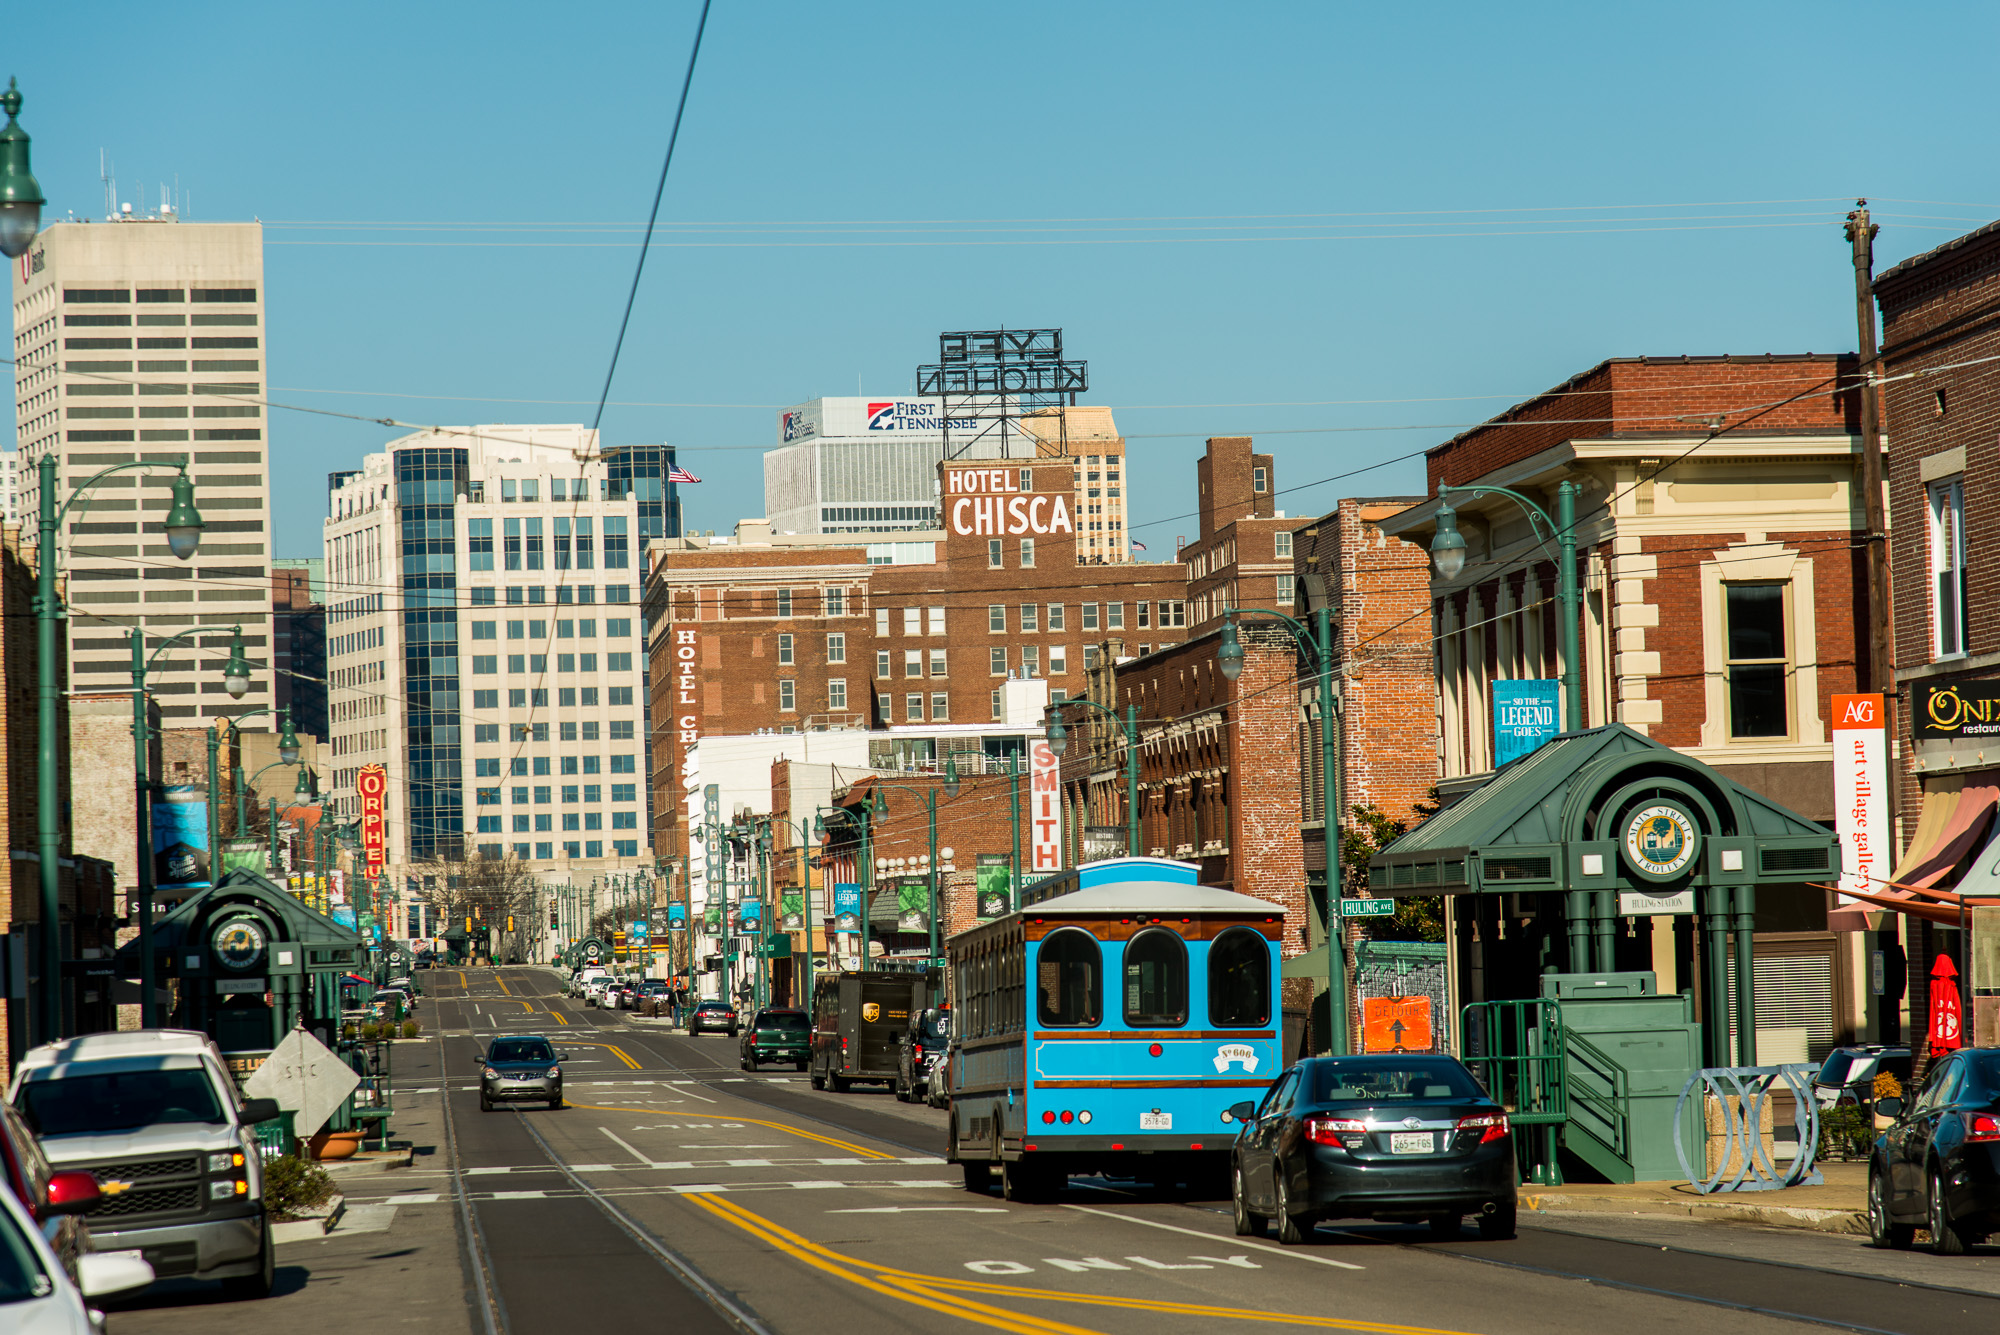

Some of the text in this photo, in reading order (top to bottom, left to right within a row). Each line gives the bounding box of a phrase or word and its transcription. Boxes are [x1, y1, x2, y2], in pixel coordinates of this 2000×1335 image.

[895, 402, 936, 416] FIRST
[894, 416, 978, 430] TENNESSEE
[949, 469, 1018, 494] HOTEL
[952, 495, 1073, 536] CHISCA
[676, 630, 697, 704] HOTEL
[1512, 697, 1541, 706] SO THE
[1501, 706, 1553, 726] LEGEND
[1513, 726, 1542, 737] GOES
[1962, 723, 2000, 734] restaur
[1033, 743, 1058, 868] SMITH
[1629, 807, 1692, 836] MAIN STREET
[1851, 740, 1874, 893] art village gallery
[1637, 857, 1687, 874] TROLLEY
[838, 893, 858, 901] LEGEND
[1631, 898, 1683, 909] HULING STATION
[1345, 901, 1392, 914] HULING AVE
[865, 1008, 879, 1019] ups
[1375, 1005, 1420, 1017] DETOUR
[1233, 1048, 1252, 1058] 606
[963, 1255, 1263, 1275] ONLY
